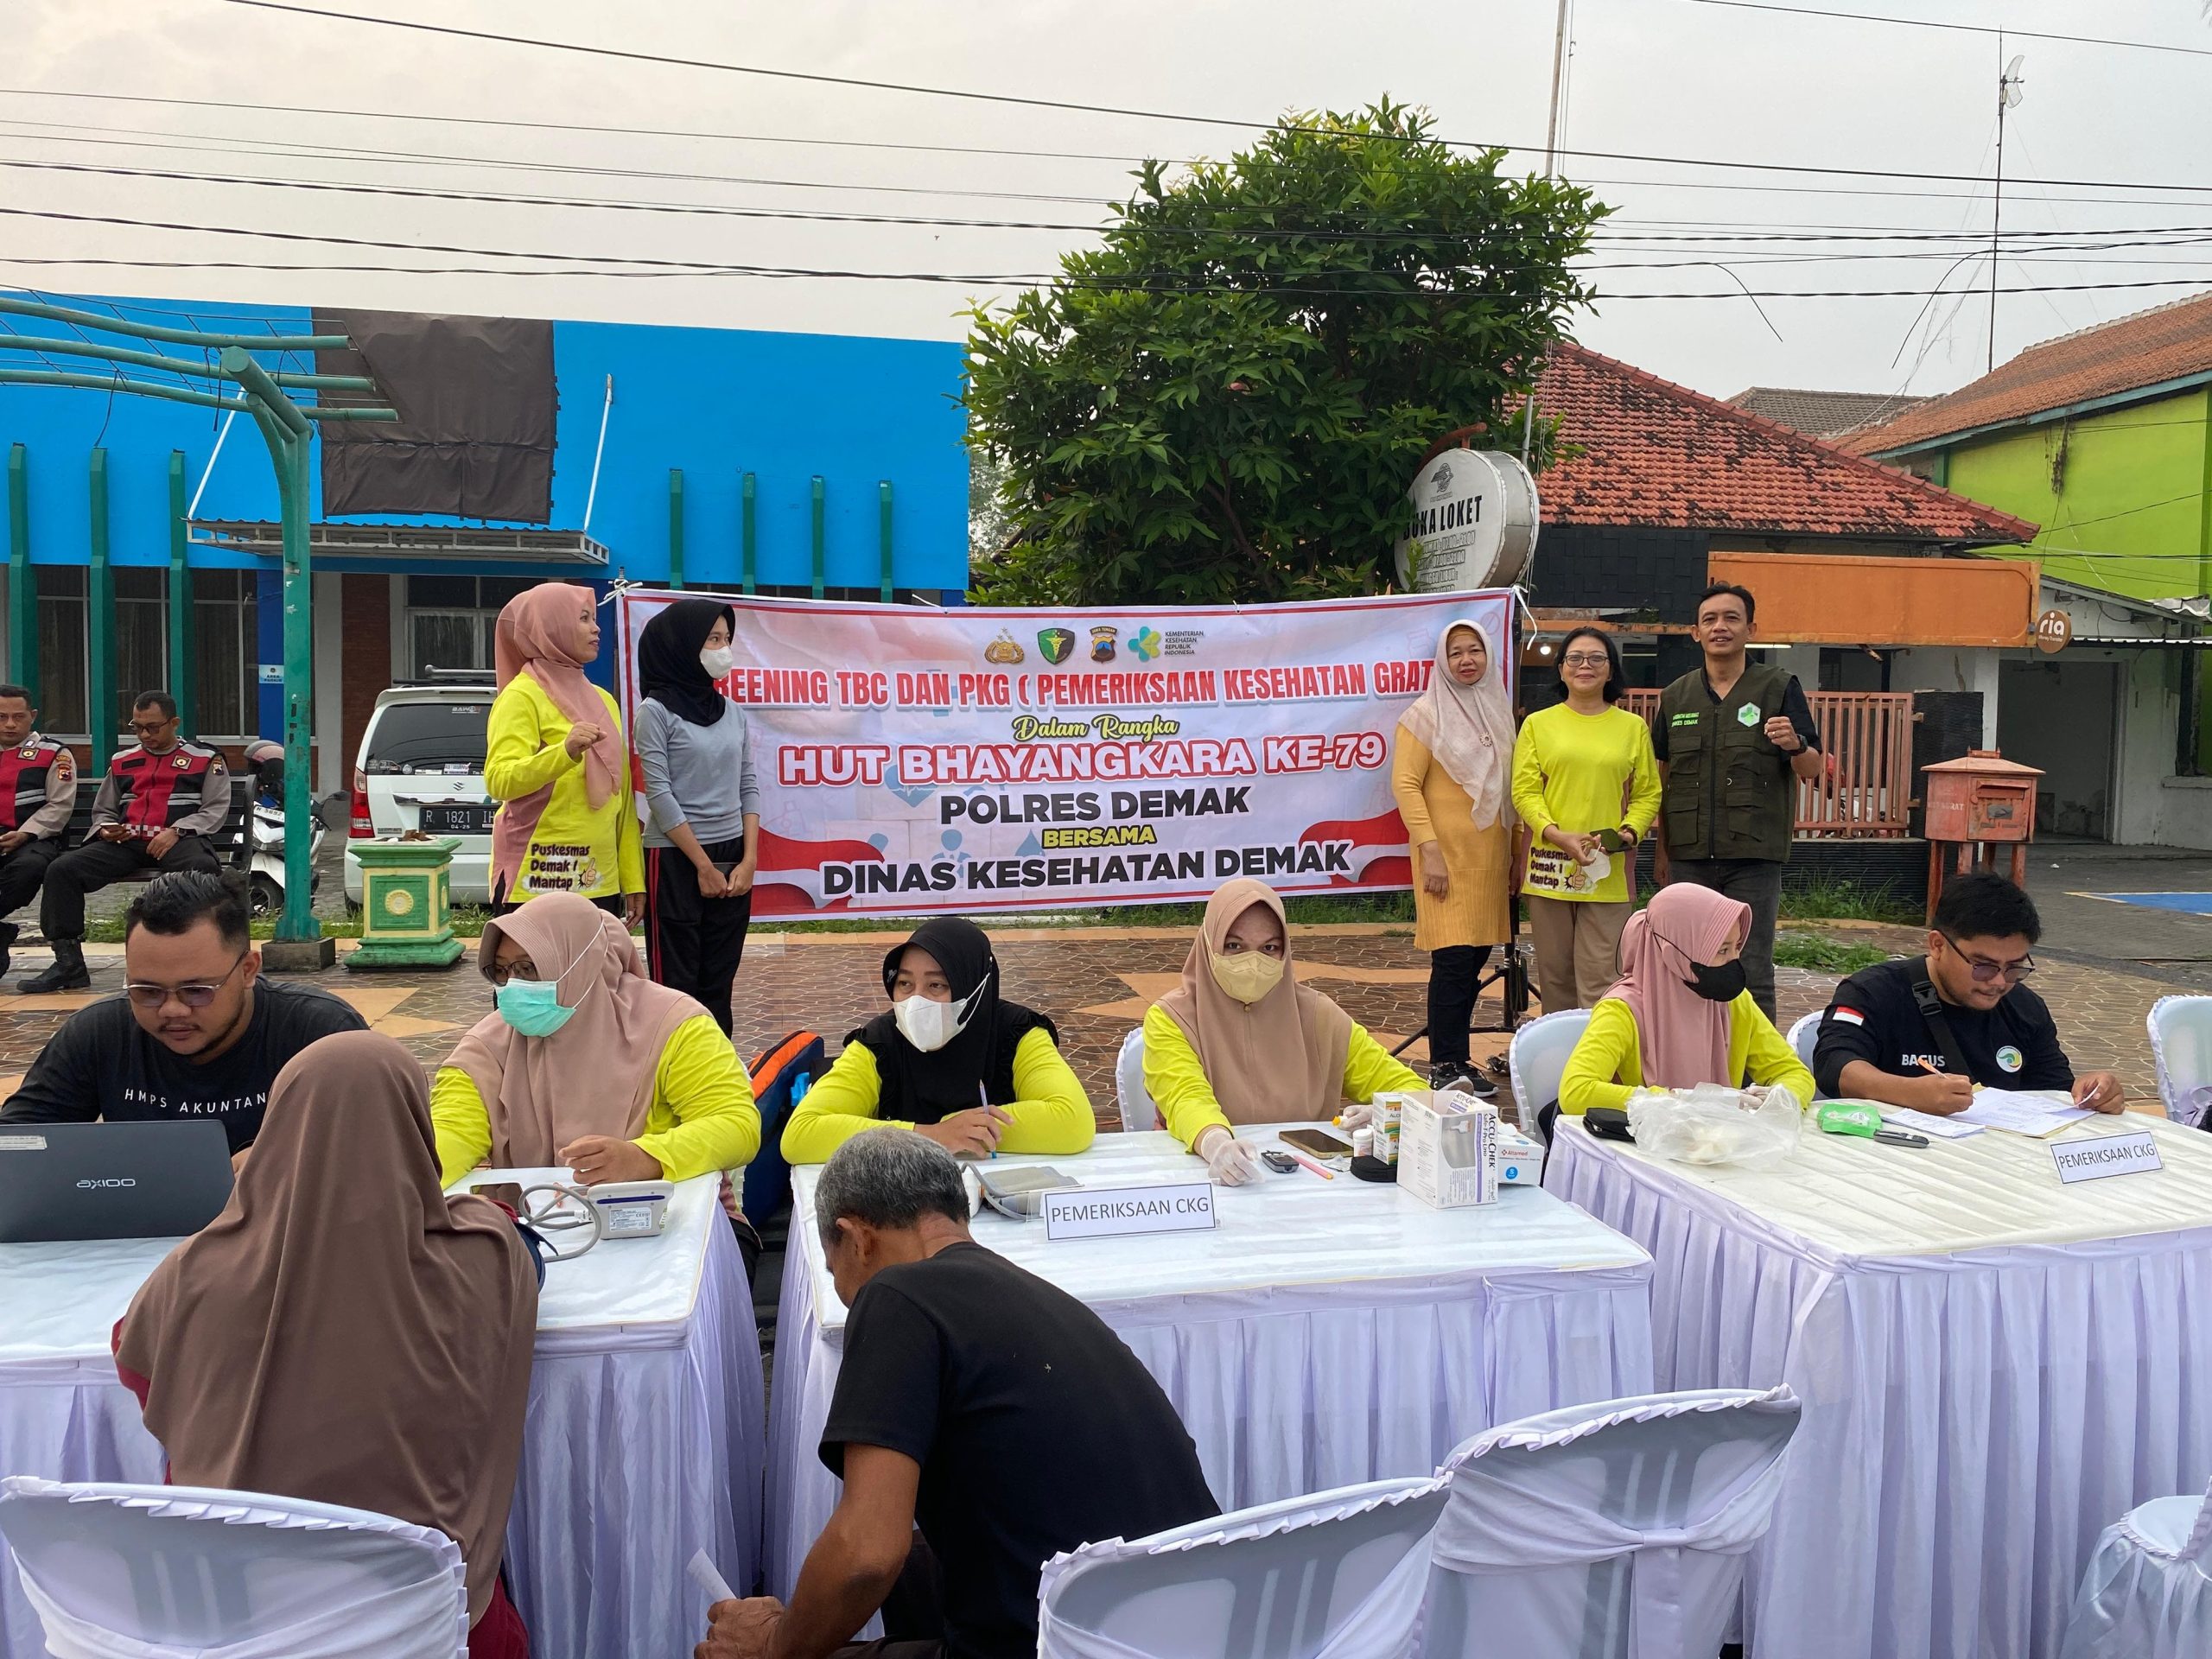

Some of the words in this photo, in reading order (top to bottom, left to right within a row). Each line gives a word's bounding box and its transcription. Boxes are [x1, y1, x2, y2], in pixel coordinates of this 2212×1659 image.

[1440, 495, 1482, 531] LOKET
[2040, 612, 2065, 636] ria
[836, 671, 888, 705] TBC
[896, 672, 950, 705] DAN
[959, 673, 1011, 705] PKG
[1038, 671, 1217, 706] PEMERIKSAAN
[1224, 664, 1366, 701] KESEHATAN
[1012, 715, 1090, 741] Dalam
[1091, 714, 1180, 743] Rangka
[779, 744, 889, 786] HUT
[898, 739, 1257, 785] BHAYANGKARA
[1263, 732, 1387, 775] KE-79
[425, 810, 433, 823] R
[445, 810, 471, 823] 1821
[941, 791, 1102, 825] POLRES
[1111, 786, 1251, 820] DEMAK
[1042, 823, 1157, 849] BERSAMA
[531, 842, 591, 857] Puskesmas
[1530, 847, 1573, 861] Puskesma
[531, 859, 570, 873] Demak
[823, 862, 957, 896] DINAS
[968, 850, 1205, 891] KESEHATAN
[1215, 843, 1352, 878] DEMAK
[1530, 860, 1555, 873] Demak
[529, 875, 573, 892] Mantap
[1529, 874, 1560, 889] Mantap
[2058, 1147, 2133, 1169] PEMERIKSAAN
[2133, 1143, 2156, 1158] CKG
[1051, 1199, 1171, 1223] PEMERIKSAAN
[1175, 1197, 1210, 1214] CKG
